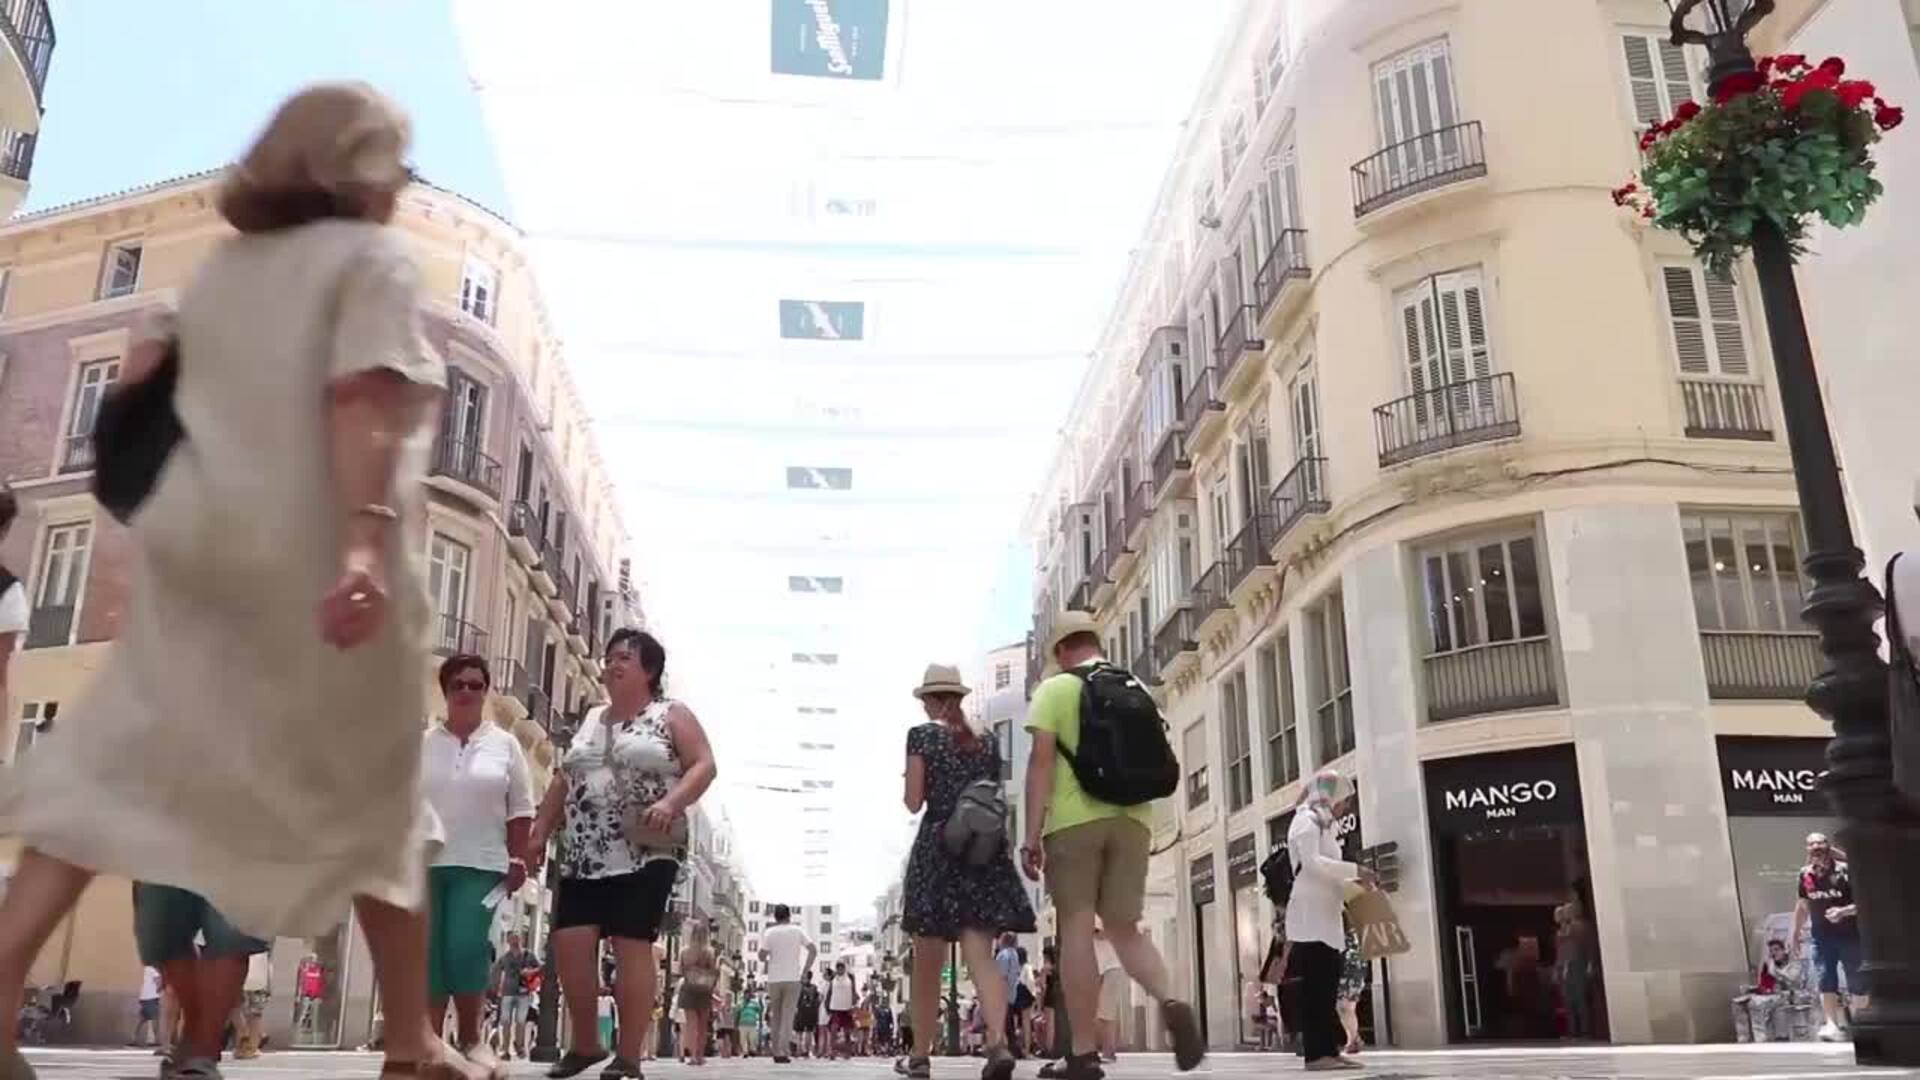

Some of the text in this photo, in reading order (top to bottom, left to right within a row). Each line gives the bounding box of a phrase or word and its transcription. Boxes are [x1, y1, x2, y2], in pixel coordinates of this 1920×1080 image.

[1732, 769, 1830, 790] MANG
[1445, 780, 1557, 810] MANGO
[1773, 793, 1803, 803] MAN
[1486, 806, 1516, 819] MAN
